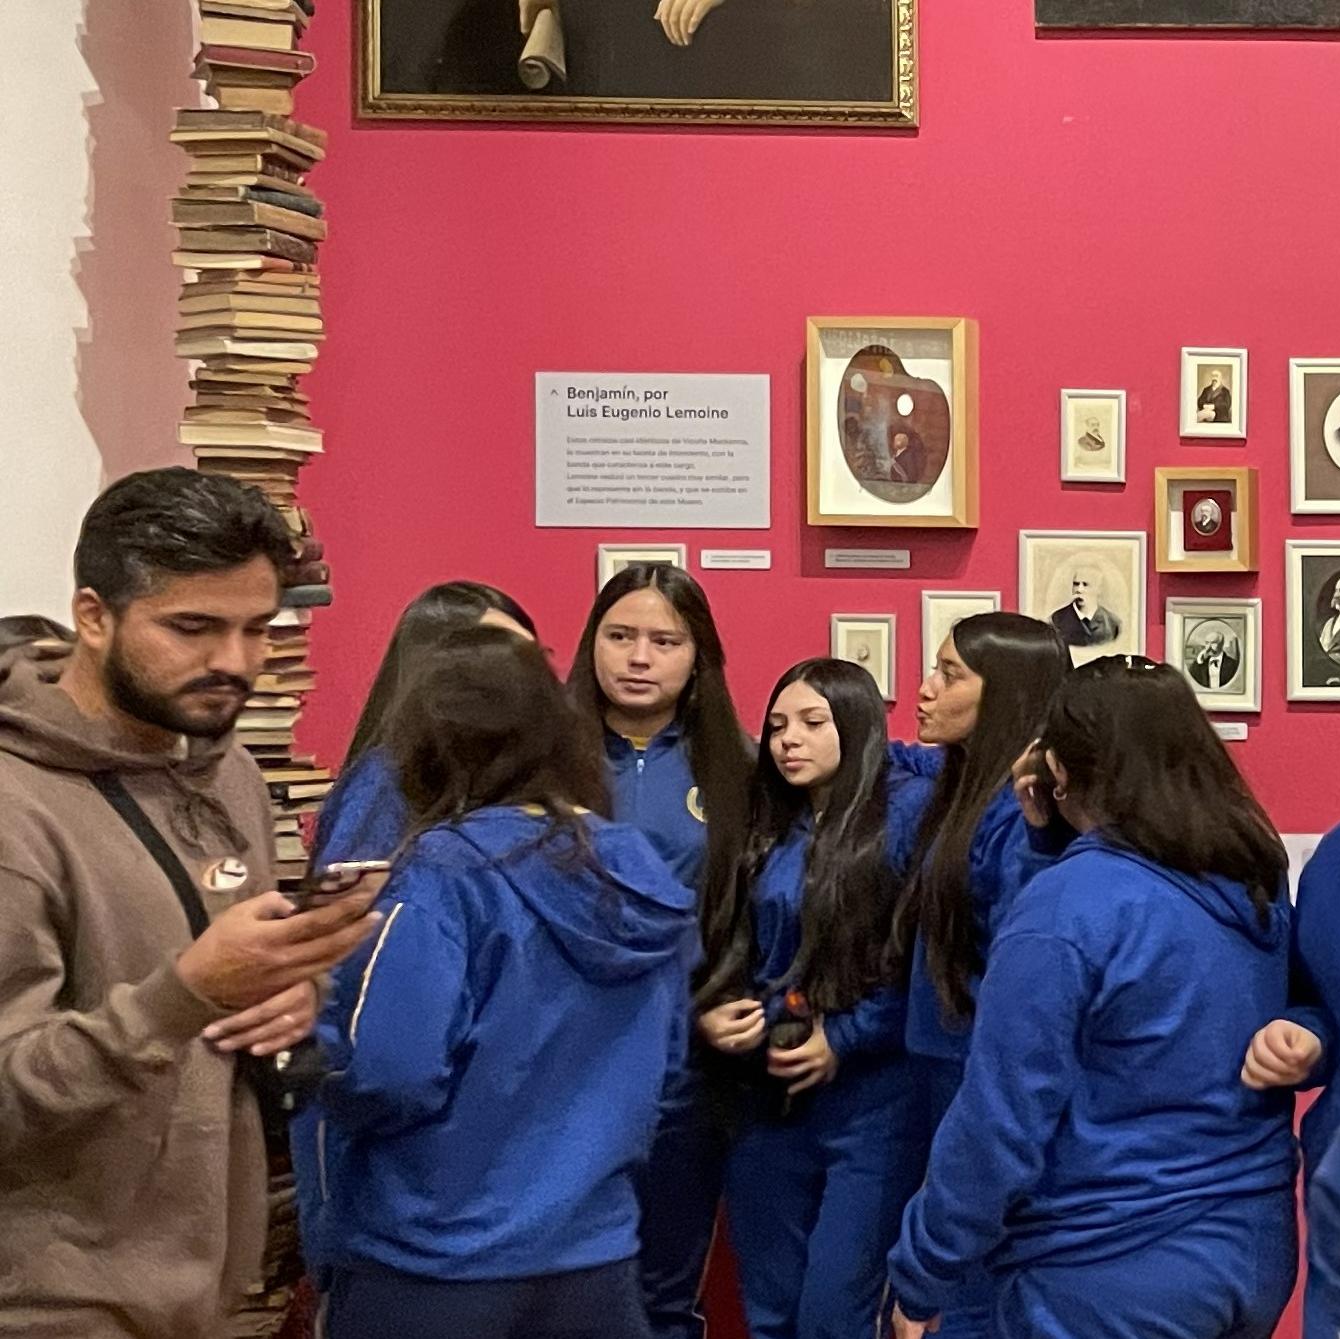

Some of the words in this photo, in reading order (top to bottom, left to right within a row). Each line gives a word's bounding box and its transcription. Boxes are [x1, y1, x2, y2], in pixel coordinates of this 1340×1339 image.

[567, 385, 640, 402] Benjamín,
[643, 389, 669, 402] por
[567, 404, 597, 418] Luis
[602, 405, 662, 421] Eugenio
[666, 405, 729, 419] Lemoine
